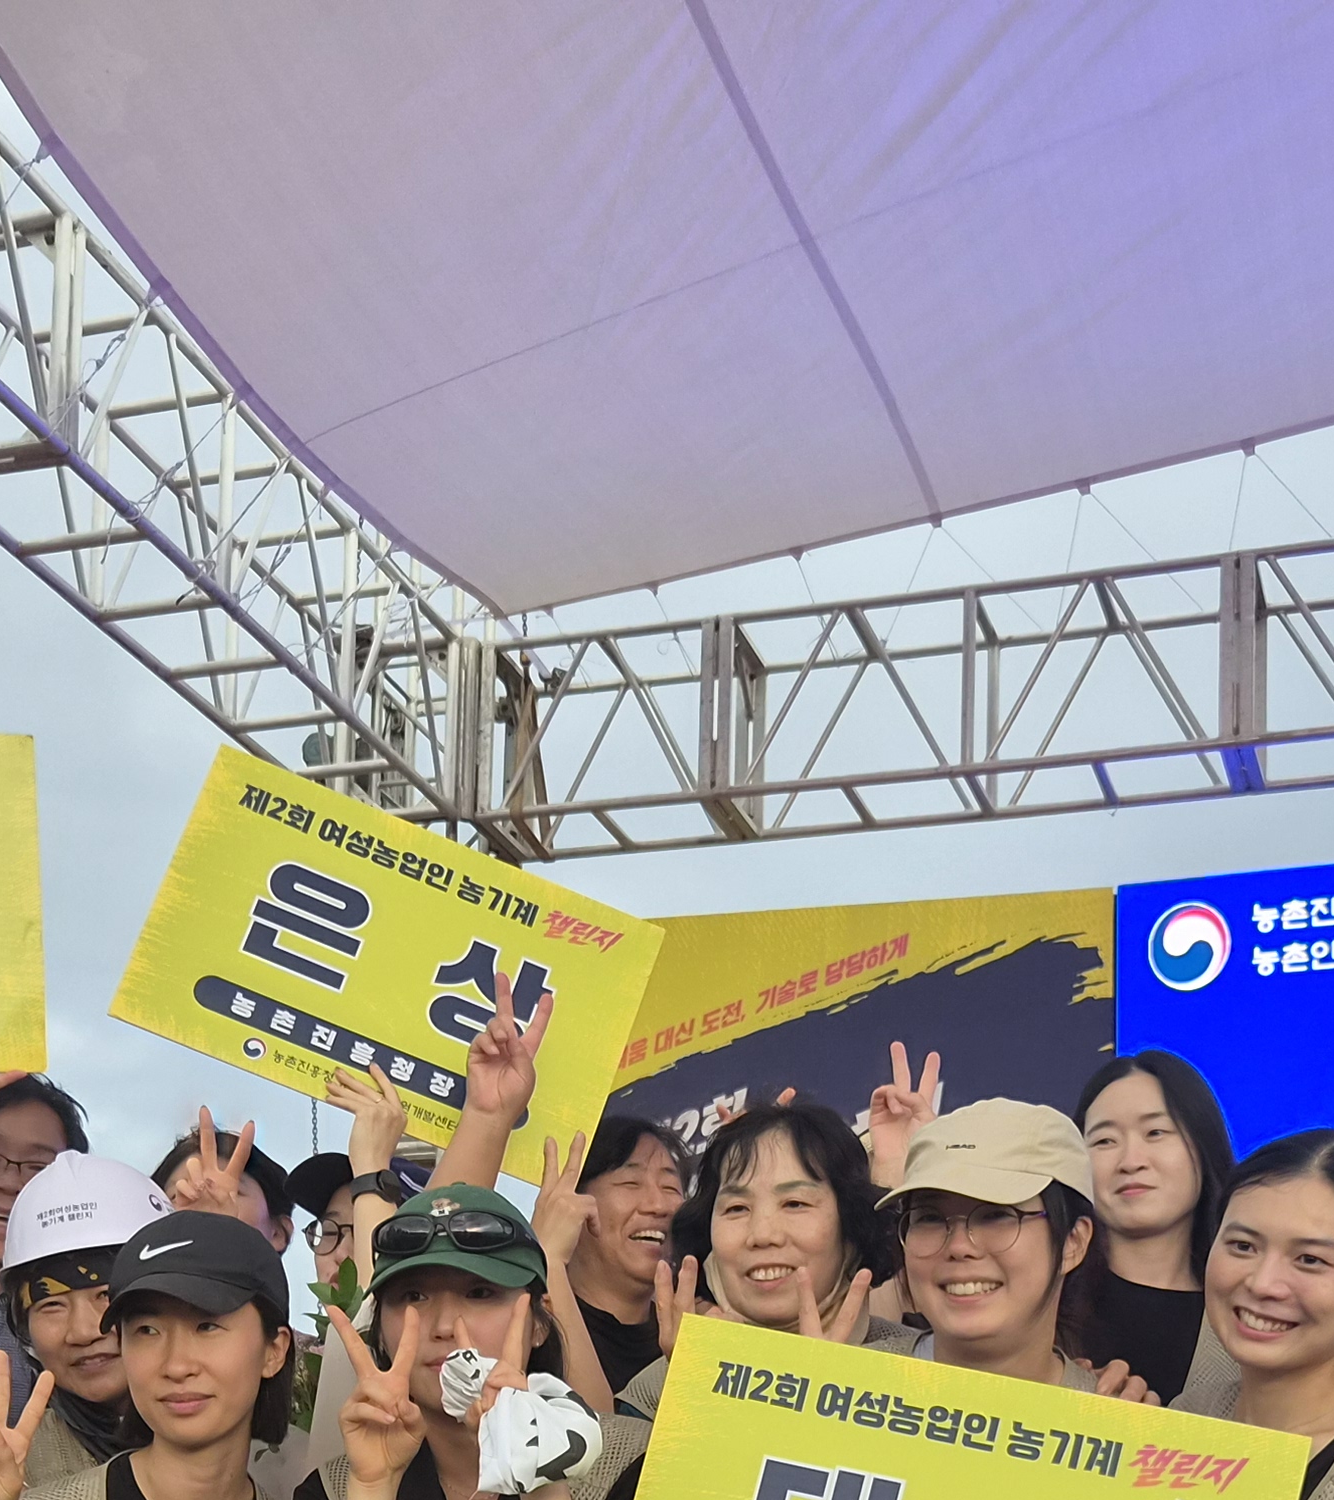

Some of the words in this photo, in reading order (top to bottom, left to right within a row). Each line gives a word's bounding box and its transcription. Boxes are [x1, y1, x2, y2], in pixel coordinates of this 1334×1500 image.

[238, 783, 316, 836] 제2회
[318, 817, 455, 893] 여성농업인
[459, 873, 540, 929] 농기계
[541, 908, 625, 954] 챌린지
[231, 991, 457, 1099] 농촌진흥청장
[654, 1018, 696, 1055] 대신
[755, 968, 819, 1015] 기술로
[824, 932, 910, 987] 당당하게
[273, 1049, 336, 1085] 농촌진흥청
[712, 1360, 810, 1414] 제2회
[815, 1382, 1000, 1450] 여성농업인
[1006, 1420, 1125, 1479] 농기계
[1128, 1443, 1251, 1496] 챌린지
